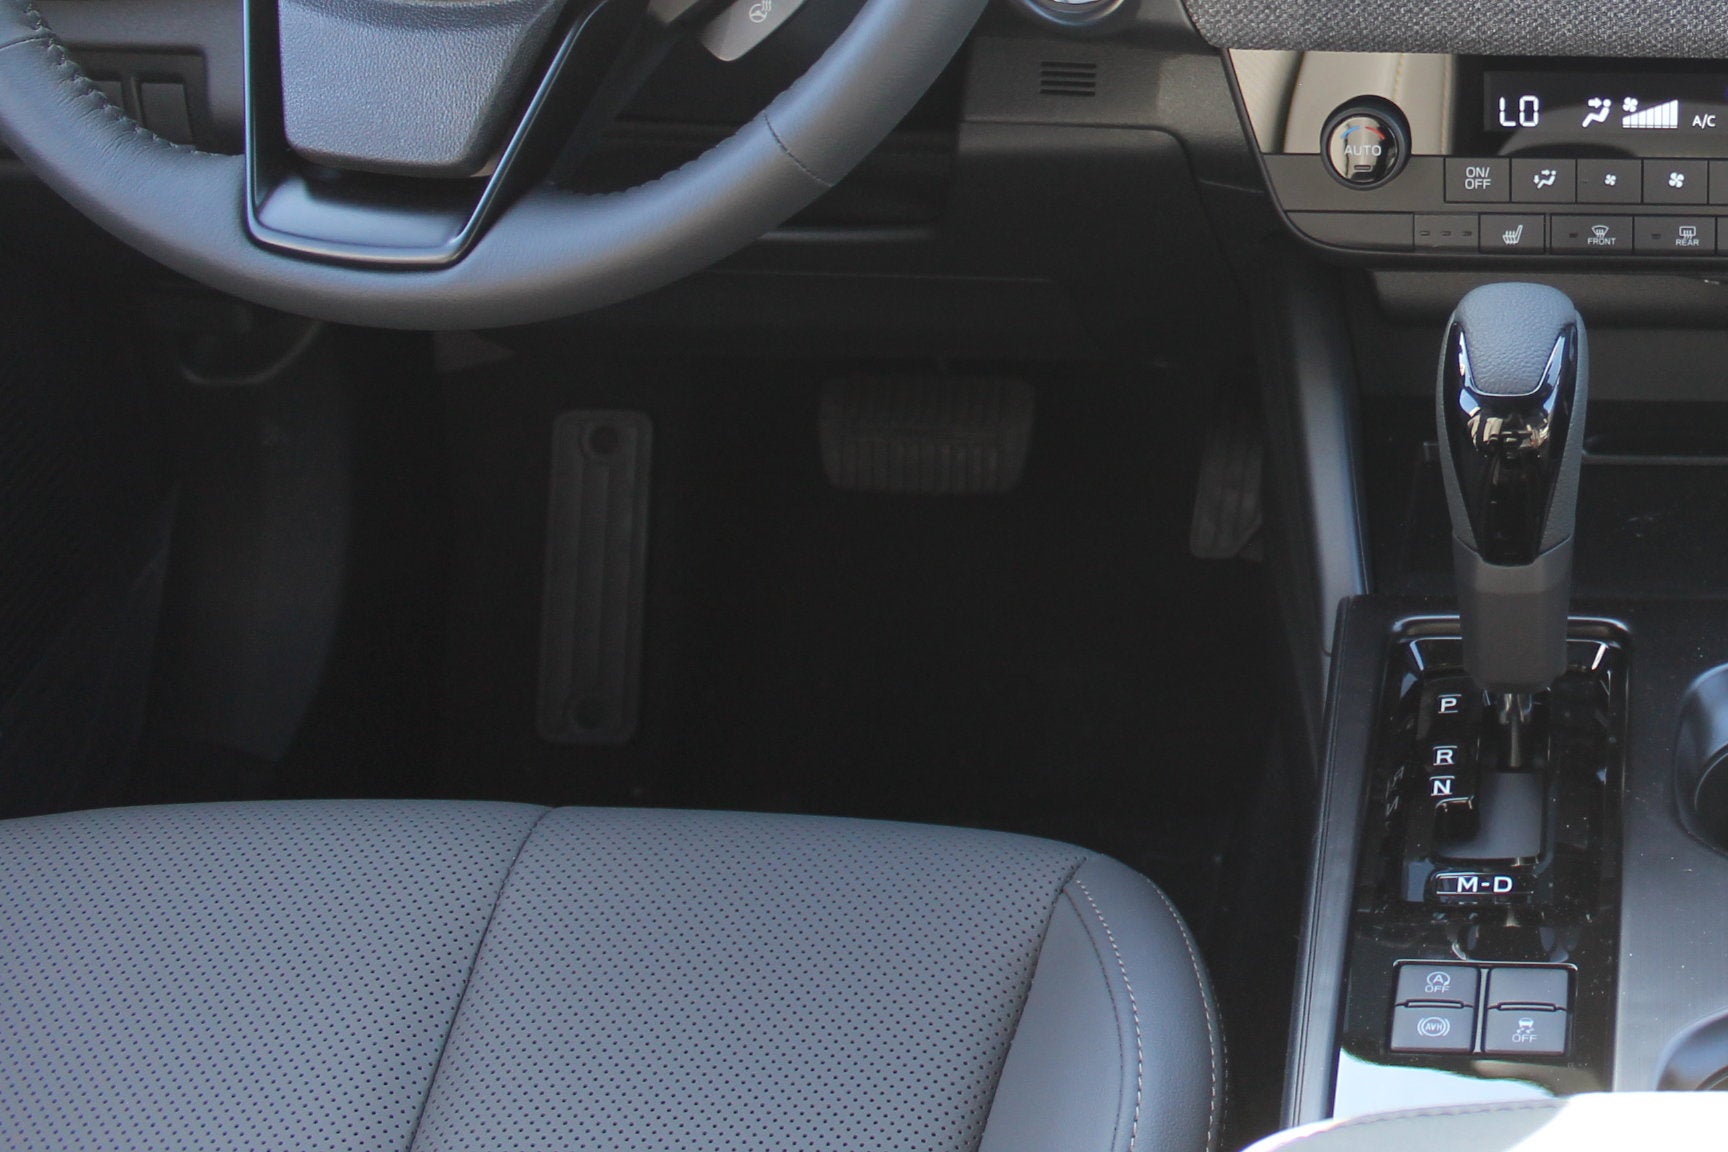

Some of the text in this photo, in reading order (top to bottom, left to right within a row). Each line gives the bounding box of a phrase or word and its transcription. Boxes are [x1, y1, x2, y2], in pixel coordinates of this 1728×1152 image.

[1499, 95, 1540, 128] LO
[1692, 114, 1717, 129] A/C
[1344, 144, 1382, 157] AUTO
[1465, 166, 1490, 179] ON/
[1464, 179, 1491, 190] OFF
[1587, 237, 1616, 246] FRONT
[1675, 238, 1700, 247] REAR
[1440, 698, 1457, 712] P
[1435, 749, 1455, 764] R
[1432, 780, 1452, 795] N
[1424, 985, 1451, 993] OFF
[1512, 1034, 1538, 1043] OFF
